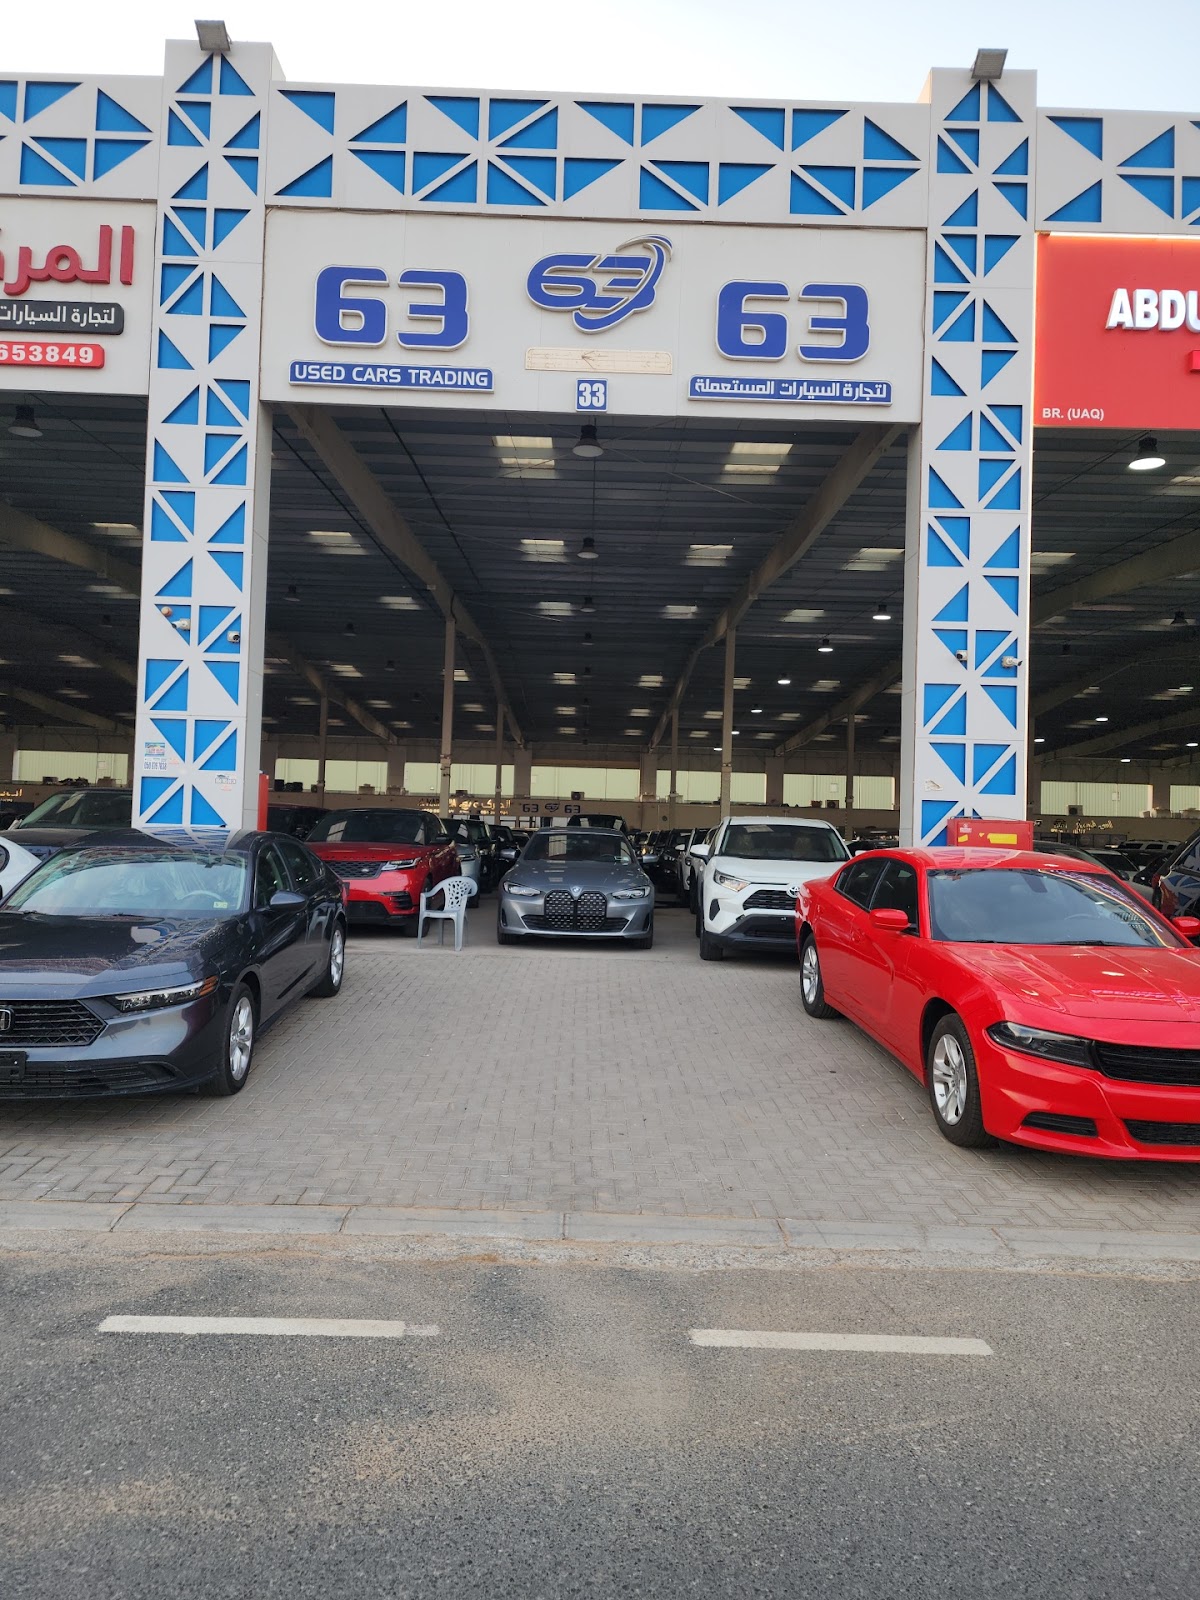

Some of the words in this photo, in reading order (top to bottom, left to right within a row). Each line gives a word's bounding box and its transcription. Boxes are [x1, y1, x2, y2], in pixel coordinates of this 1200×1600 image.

[0, 225, 134, 296] المر
[0, 303, 67, 325] السيارات
[70, 306, 116, 328] لتجارة
[313, 264, 470, 350] 63
[716, 279, 871, 364] 63
[0, 343, 94, 364] 653849
[294, 363, 346, 381] USED
[351, 366, 402, 384] CARS
[407, 369, 488, 387] TRADING
[577, 382, 605, 407] 33
[694, 378, 775, 395] المستعملة
[779, 380, 839, 400] السيارات
[842, 383, 887, 401] لتجارة
[1041, 407, 1064, 419] BR.
[1067, 407, 1105, 422] (UAQ)
[564, 804, 581, 814] 63
